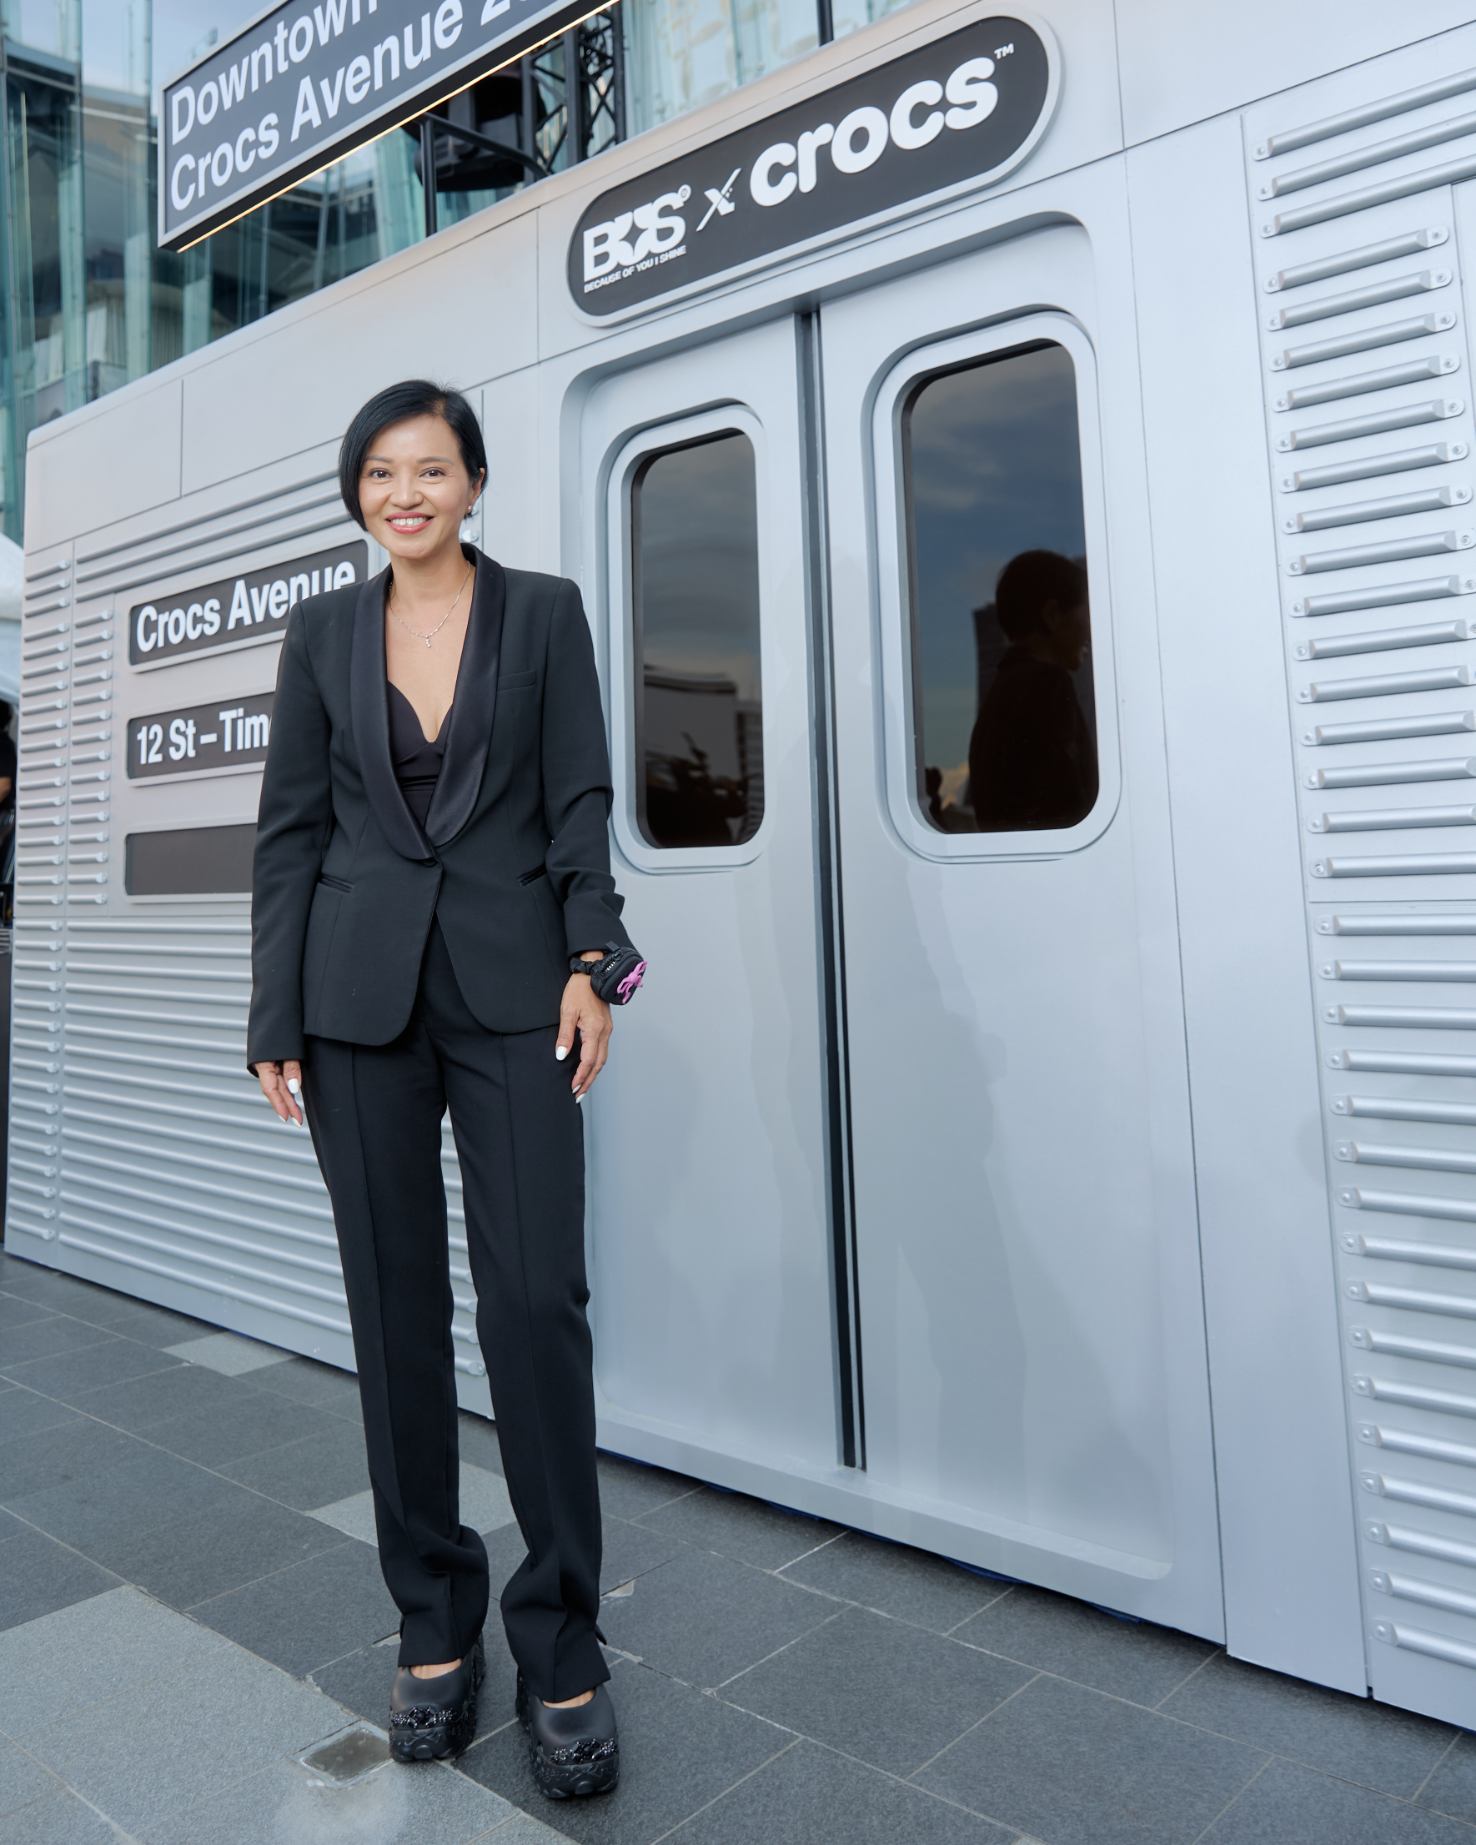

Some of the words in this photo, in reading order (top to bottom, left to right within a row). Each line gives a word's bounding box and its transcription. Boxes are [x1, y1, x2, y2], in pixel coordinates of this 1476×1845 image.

[170, 113, 280, 211] Crocs
[290, 3, 464, 142] Avenue
[583, 270, 622, 294] BECAUSE
[622, 265, 636, 278] OF
[636, 258, 654, 272] YOU
[654, 256, 659, 265] I
[659, 244, 687, 264] SHINE
[136, 599, 221, 652] Crocs
[137, 723, 163, 764] 12
[168, 718, 196, 761] St
[219, 707, 272, 752] Tim
